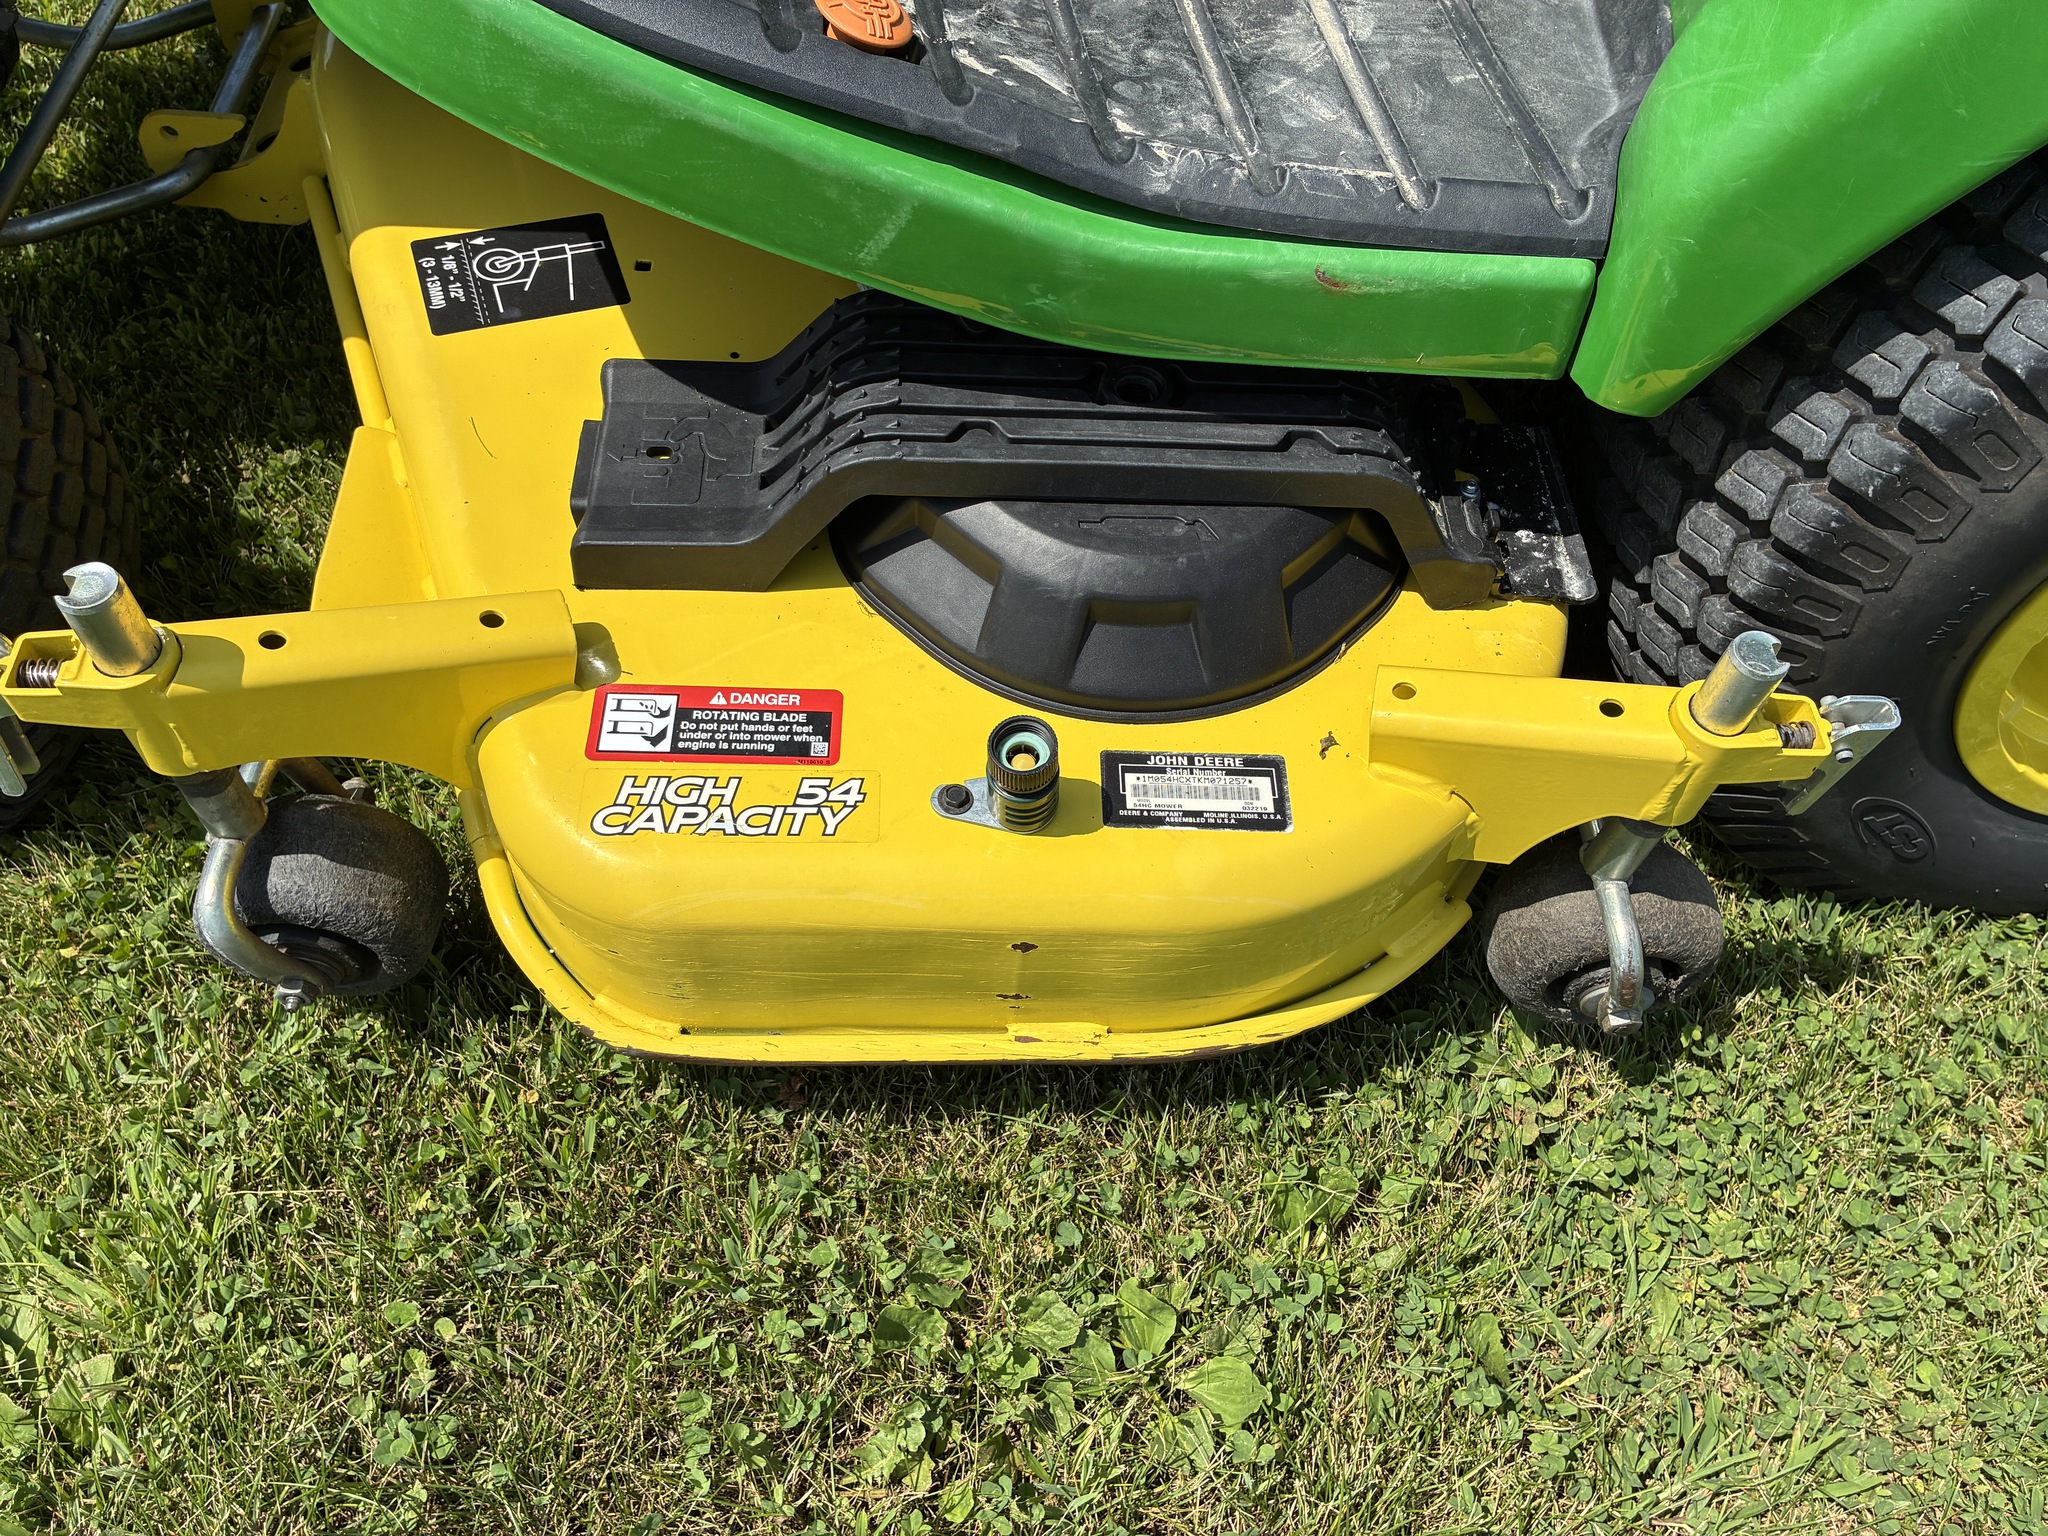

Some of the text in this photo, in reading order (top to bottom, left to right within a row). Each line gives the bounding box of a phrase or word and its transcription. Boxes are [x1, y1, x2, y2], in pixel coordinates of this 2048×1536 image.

[426, 275, 447, 310] 13MM)
[729, 692, 801, 706] DANGER
[692, 710, 807, 723] ROTATING BLADE
[681, 721, 813, 734] Do not put hands or feet
[679, 730, 823, 742] under or into mower when
[677, 740, 775, 753] engine is running
[1147, 755, 1244, 767] JOHN DEERE
[1166, 767, 1226, 776] Serial Number
[615, 775, 867, 806] HIGH 54
[590, 804, 859, 837] CAPACITY
[1863, 813, 1929, 860] CST
